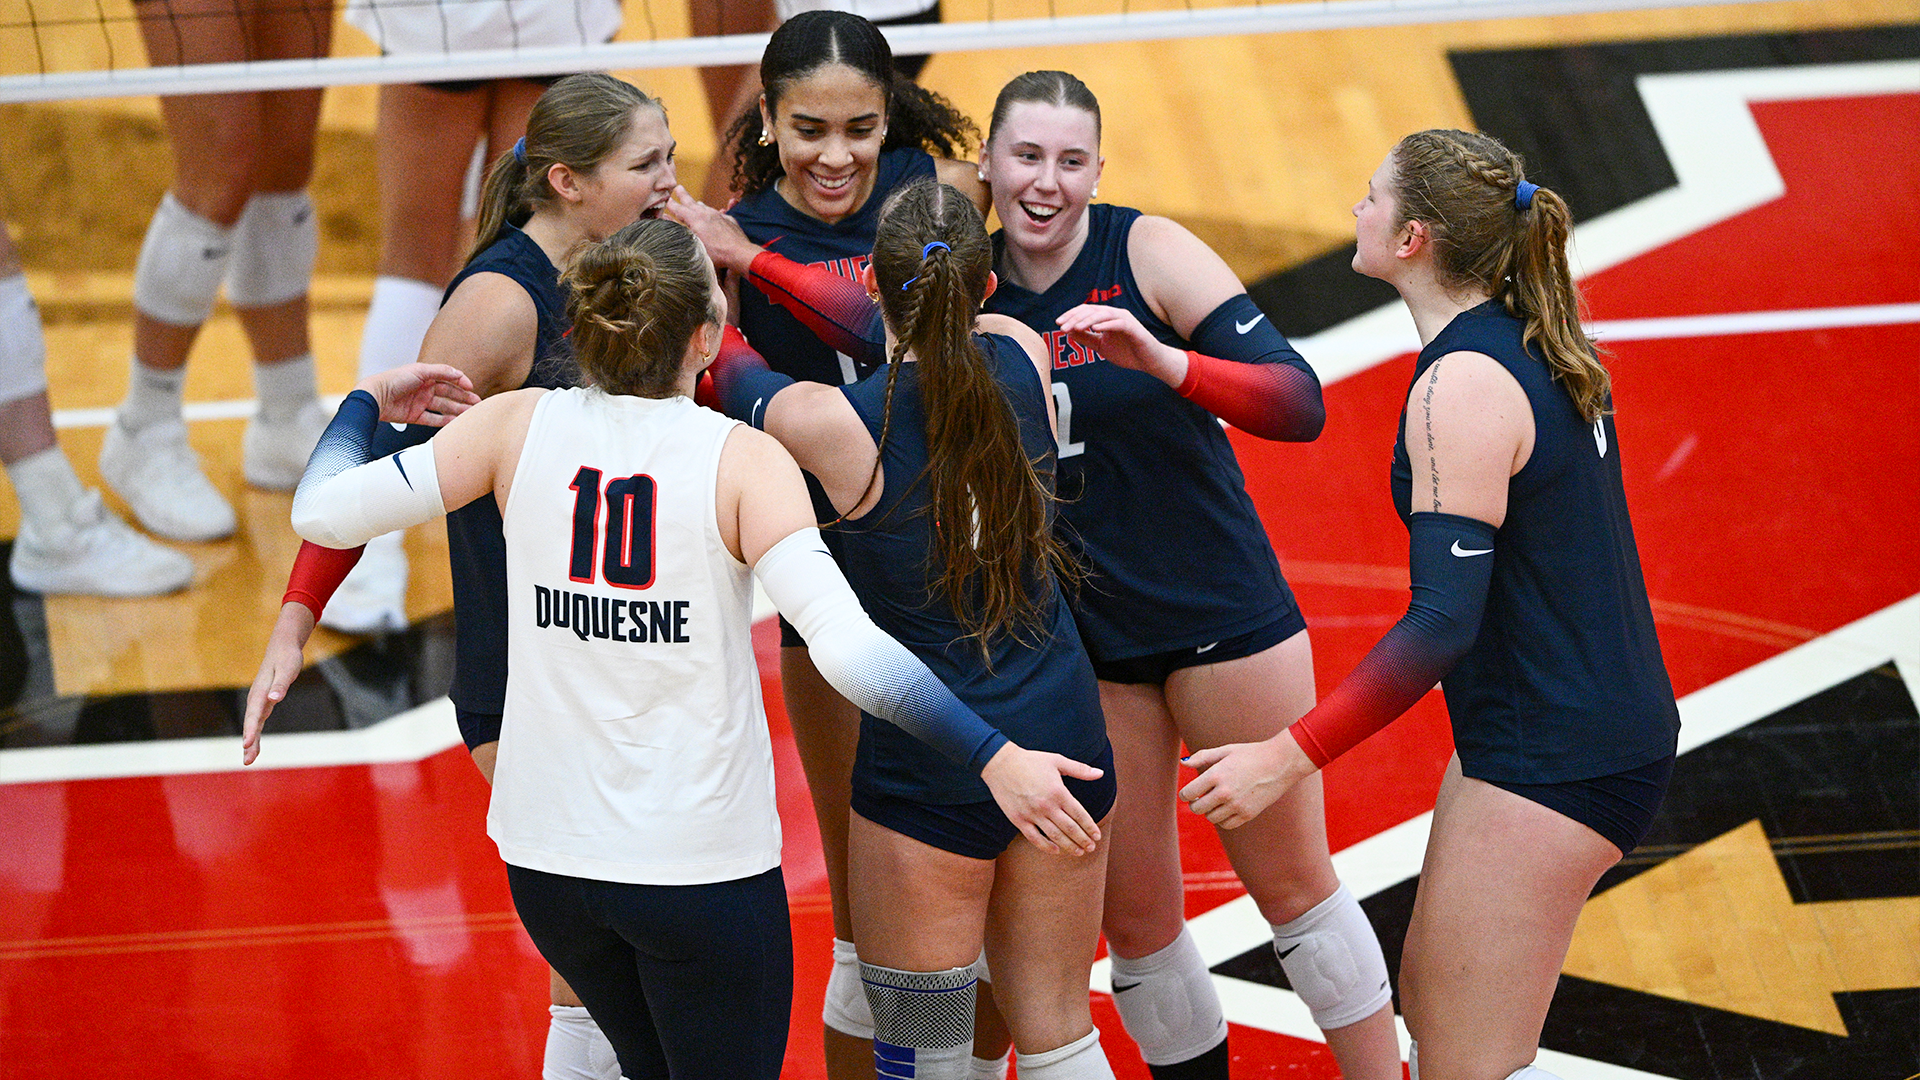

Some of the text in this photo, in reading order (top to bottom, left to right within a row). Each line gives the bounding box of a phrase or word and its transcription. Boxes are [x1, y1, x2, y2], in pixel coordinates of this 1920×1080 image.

[1423, 385, 1434, 405] thing
[1430, 457, 1439, 475] and
[568, 465, 658, 591] 10
[534, 584, 690, 643] DUQUESNE
